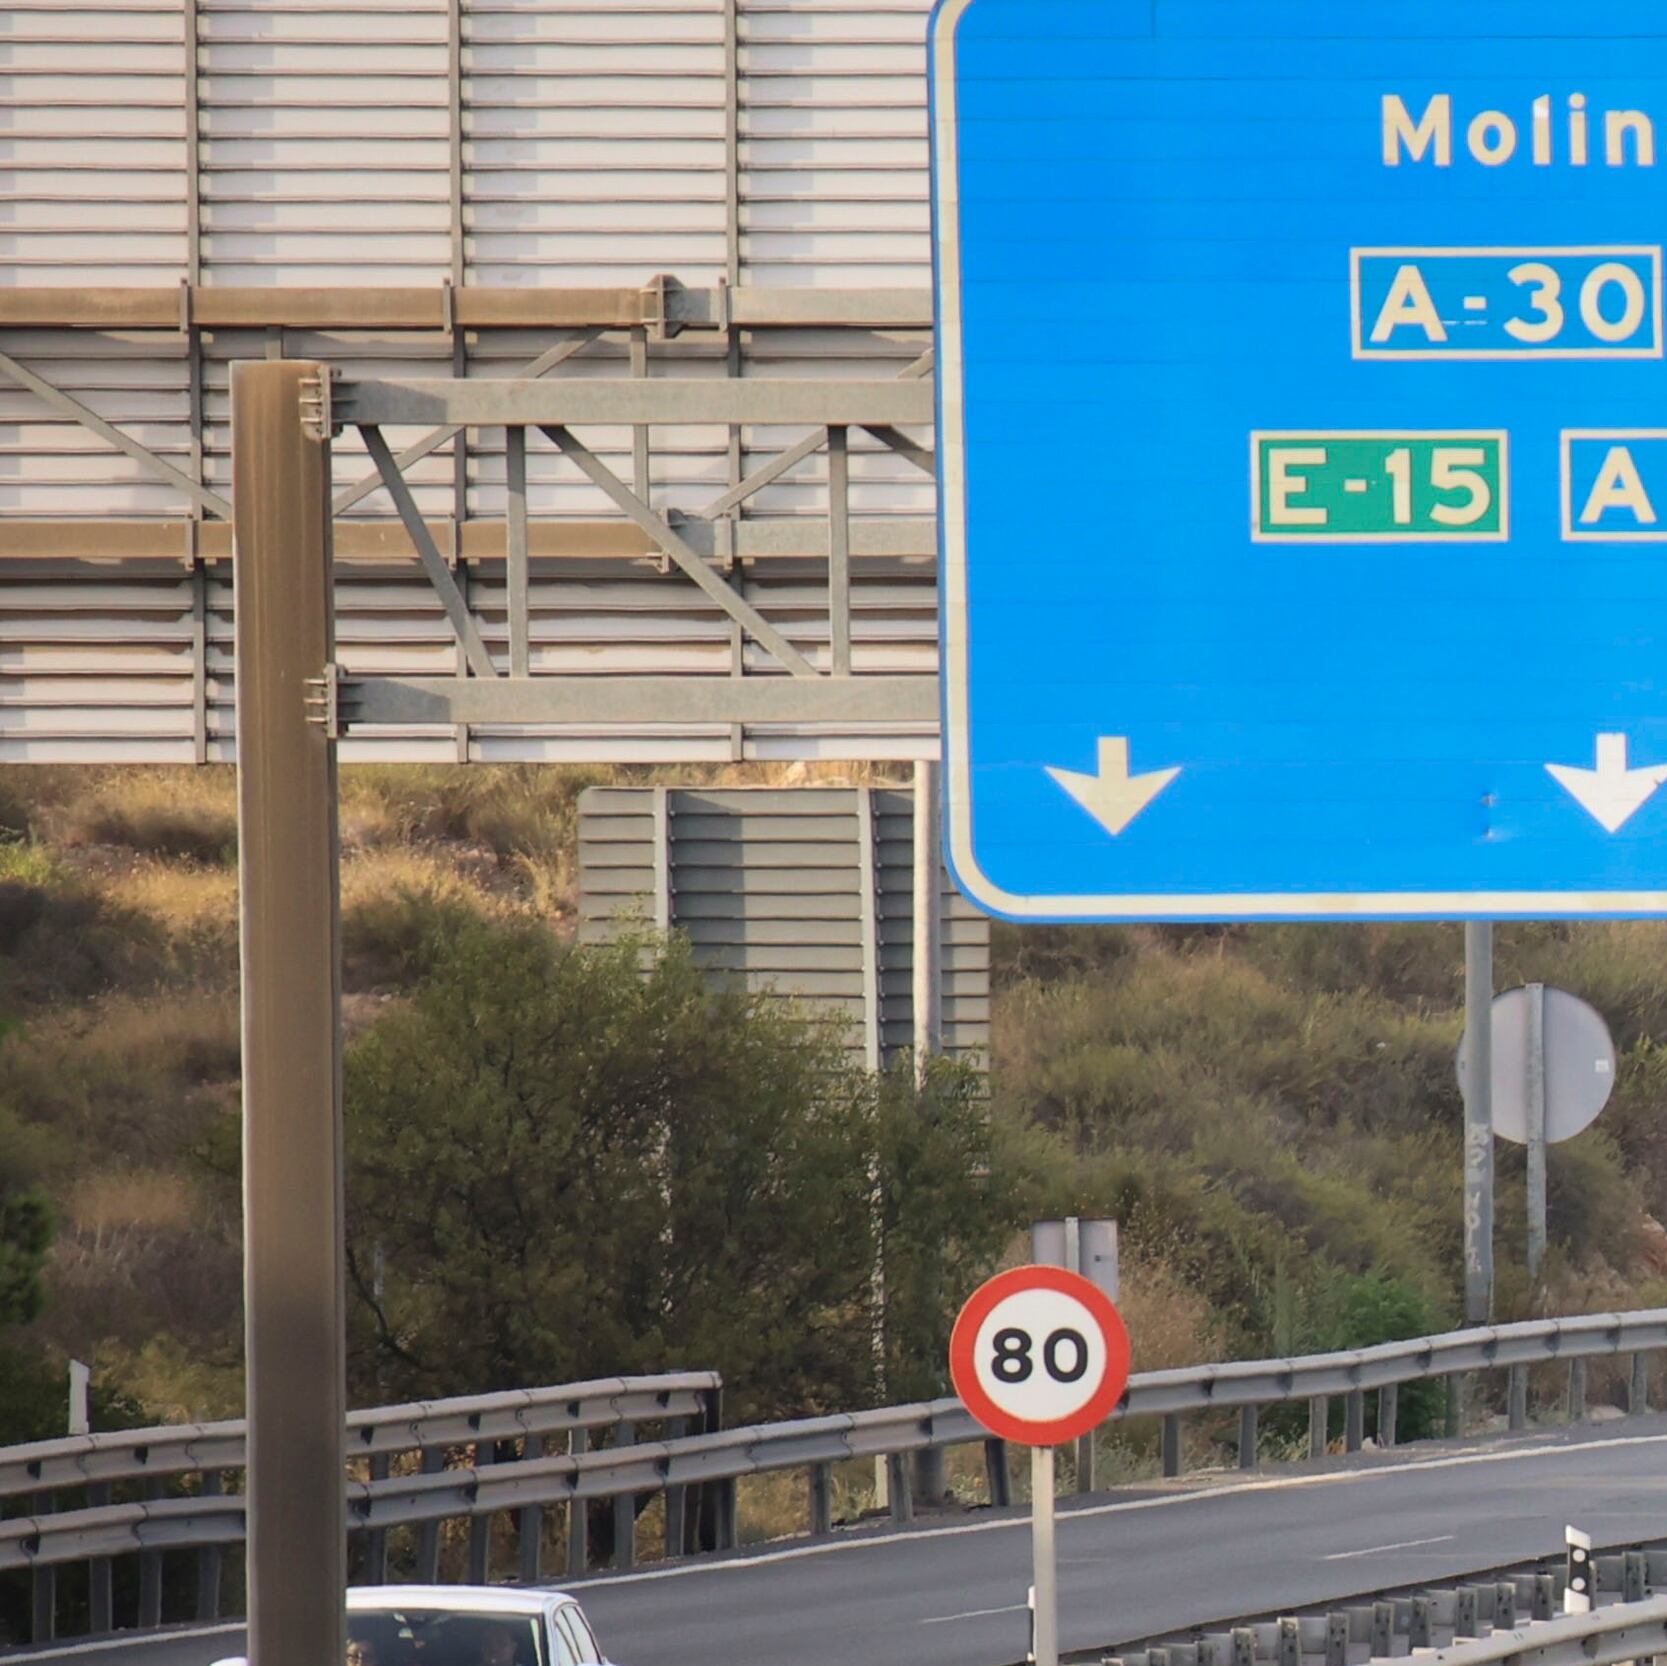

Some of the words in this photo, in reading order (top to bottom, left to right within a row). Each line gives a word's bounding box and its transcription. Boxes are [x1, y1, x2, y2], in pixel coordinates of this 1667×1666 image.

[1370, 261, 1645, 343] A-30
[1267, 445, 1492, 527] E-15
[991, 1327, 1089, 1384] 80
